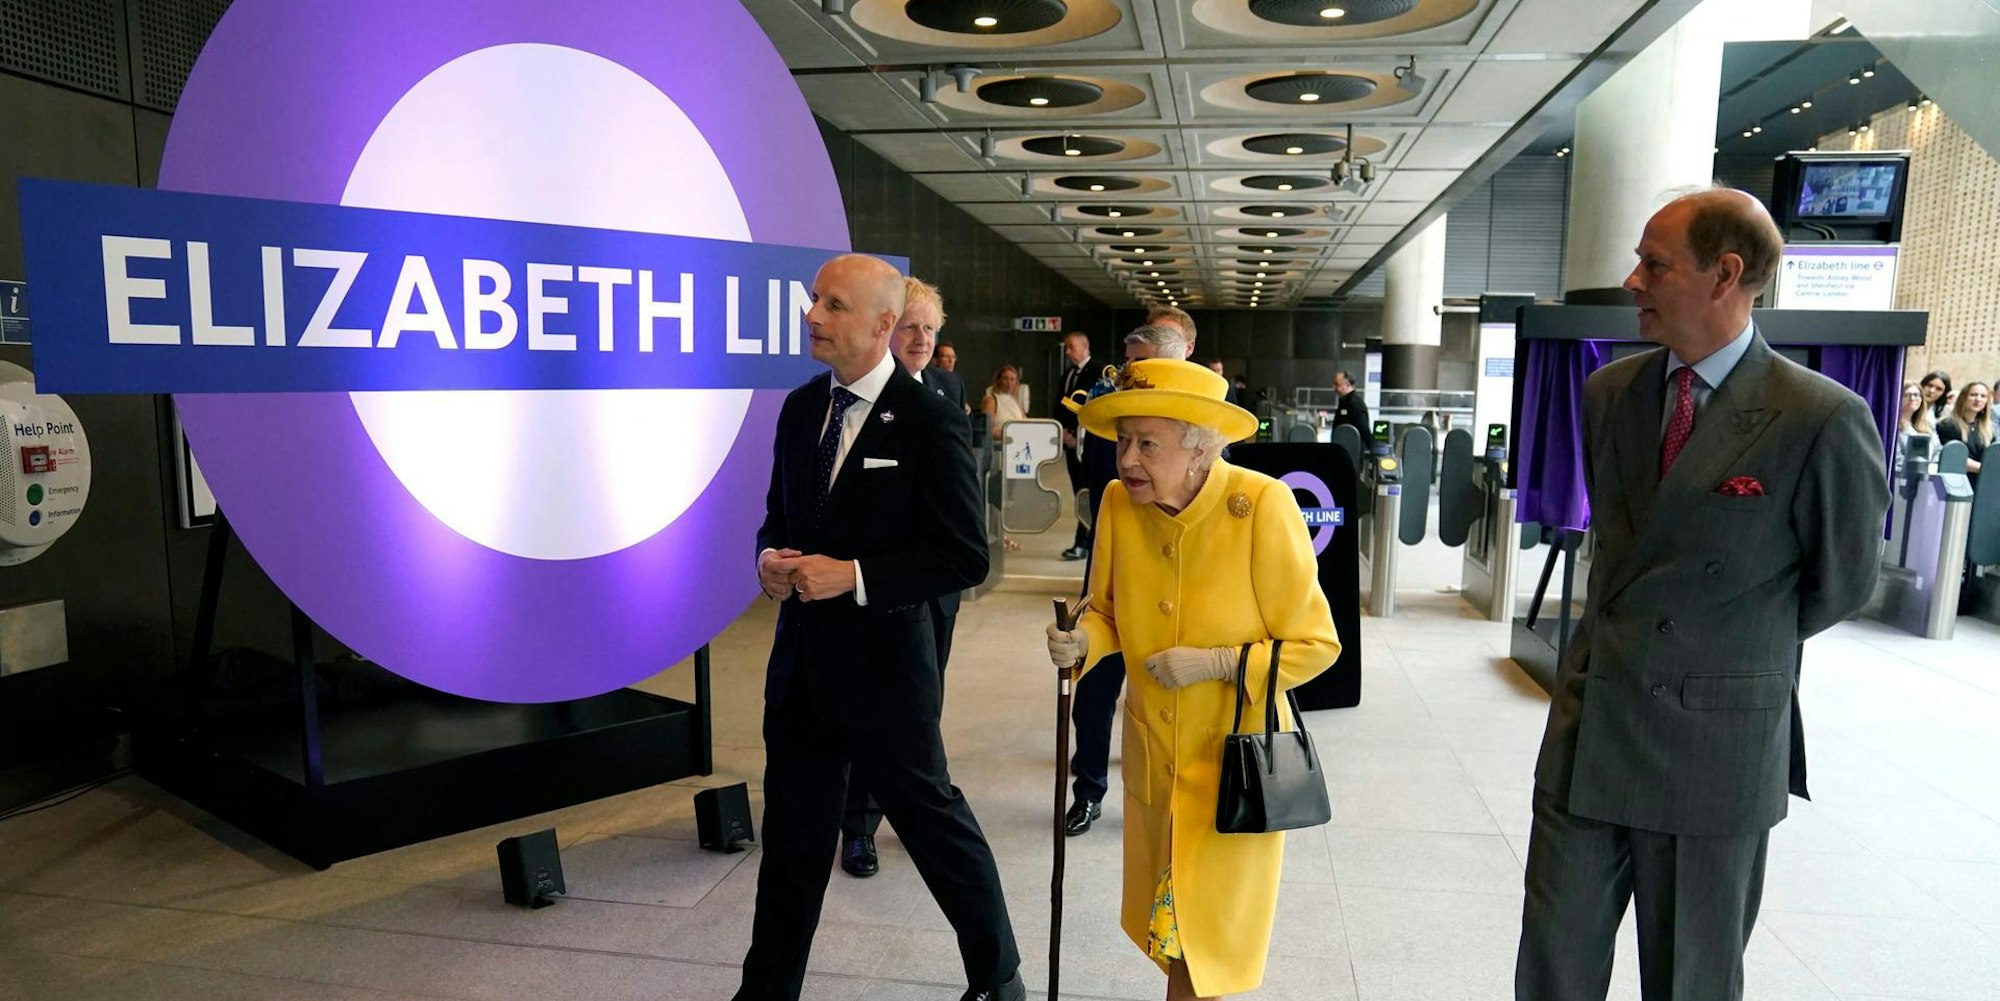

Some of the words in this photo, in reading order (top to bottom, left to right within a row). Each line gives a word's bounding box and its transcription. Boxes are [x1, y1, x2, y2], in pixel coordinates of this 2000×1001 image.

[1798, 260, 1847, 270] Elizabeth
[1851, 260, 1870, 270] line
[101, 235, 694, 353] ELIZABETH
[726, 276, 814, 355] LIN
[14, 423, 44, 438] Help
[46, 422, 74, 435] Point
[48, 486, 79, 495] Emergency
[48, 508, 81, 518] Information
[1316, 511, 1341, 523] LINE
